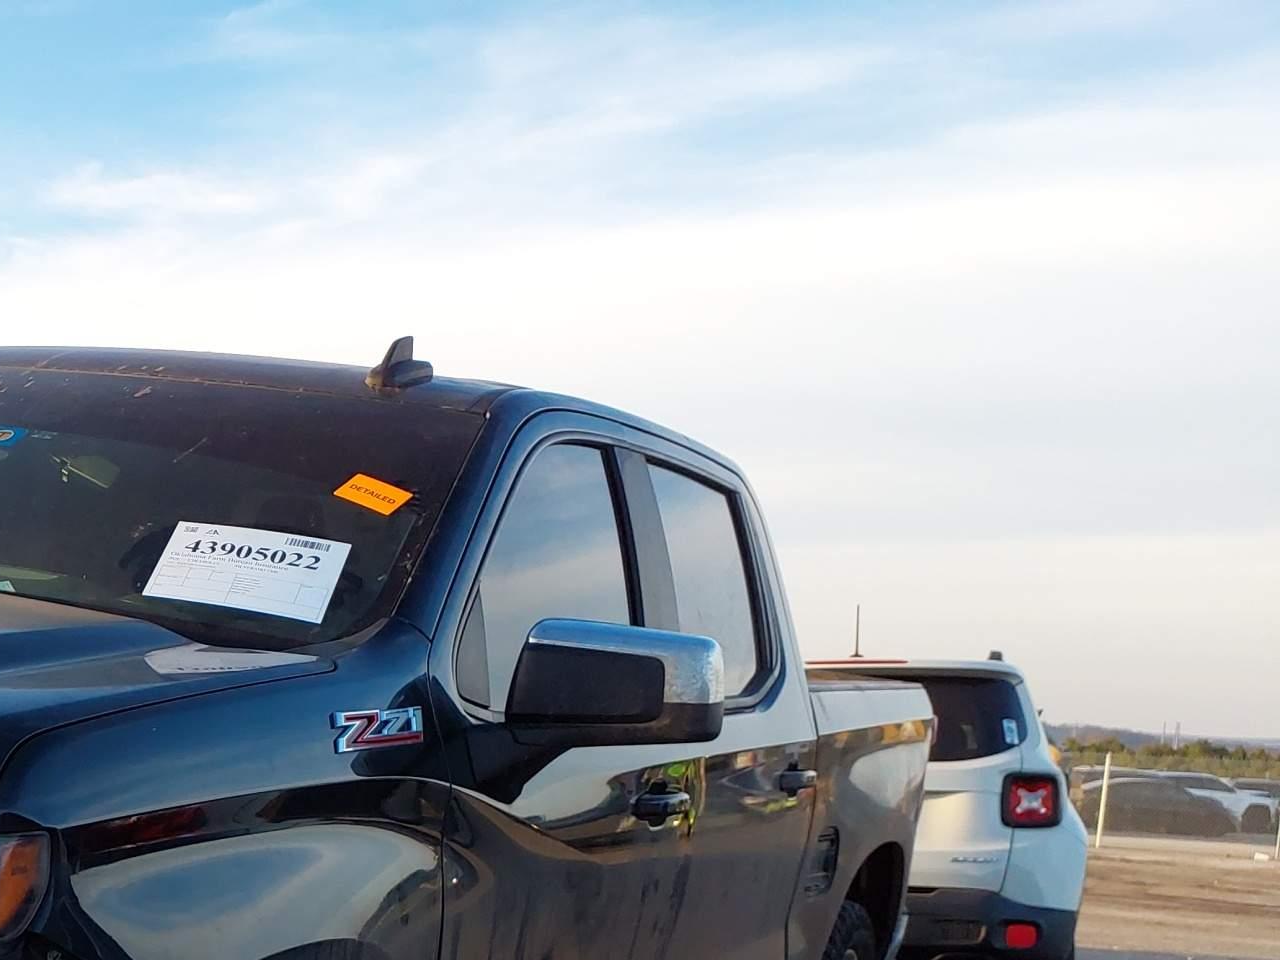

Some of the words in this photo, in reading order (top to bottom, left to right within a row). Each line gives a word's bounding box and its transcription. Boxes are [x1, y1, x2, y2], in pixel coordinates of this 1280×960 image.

[349, 484, 397, 504] DETAILED
[184, 538, 321, 571] 43905022
[328, 705, 424, 754] Z71
